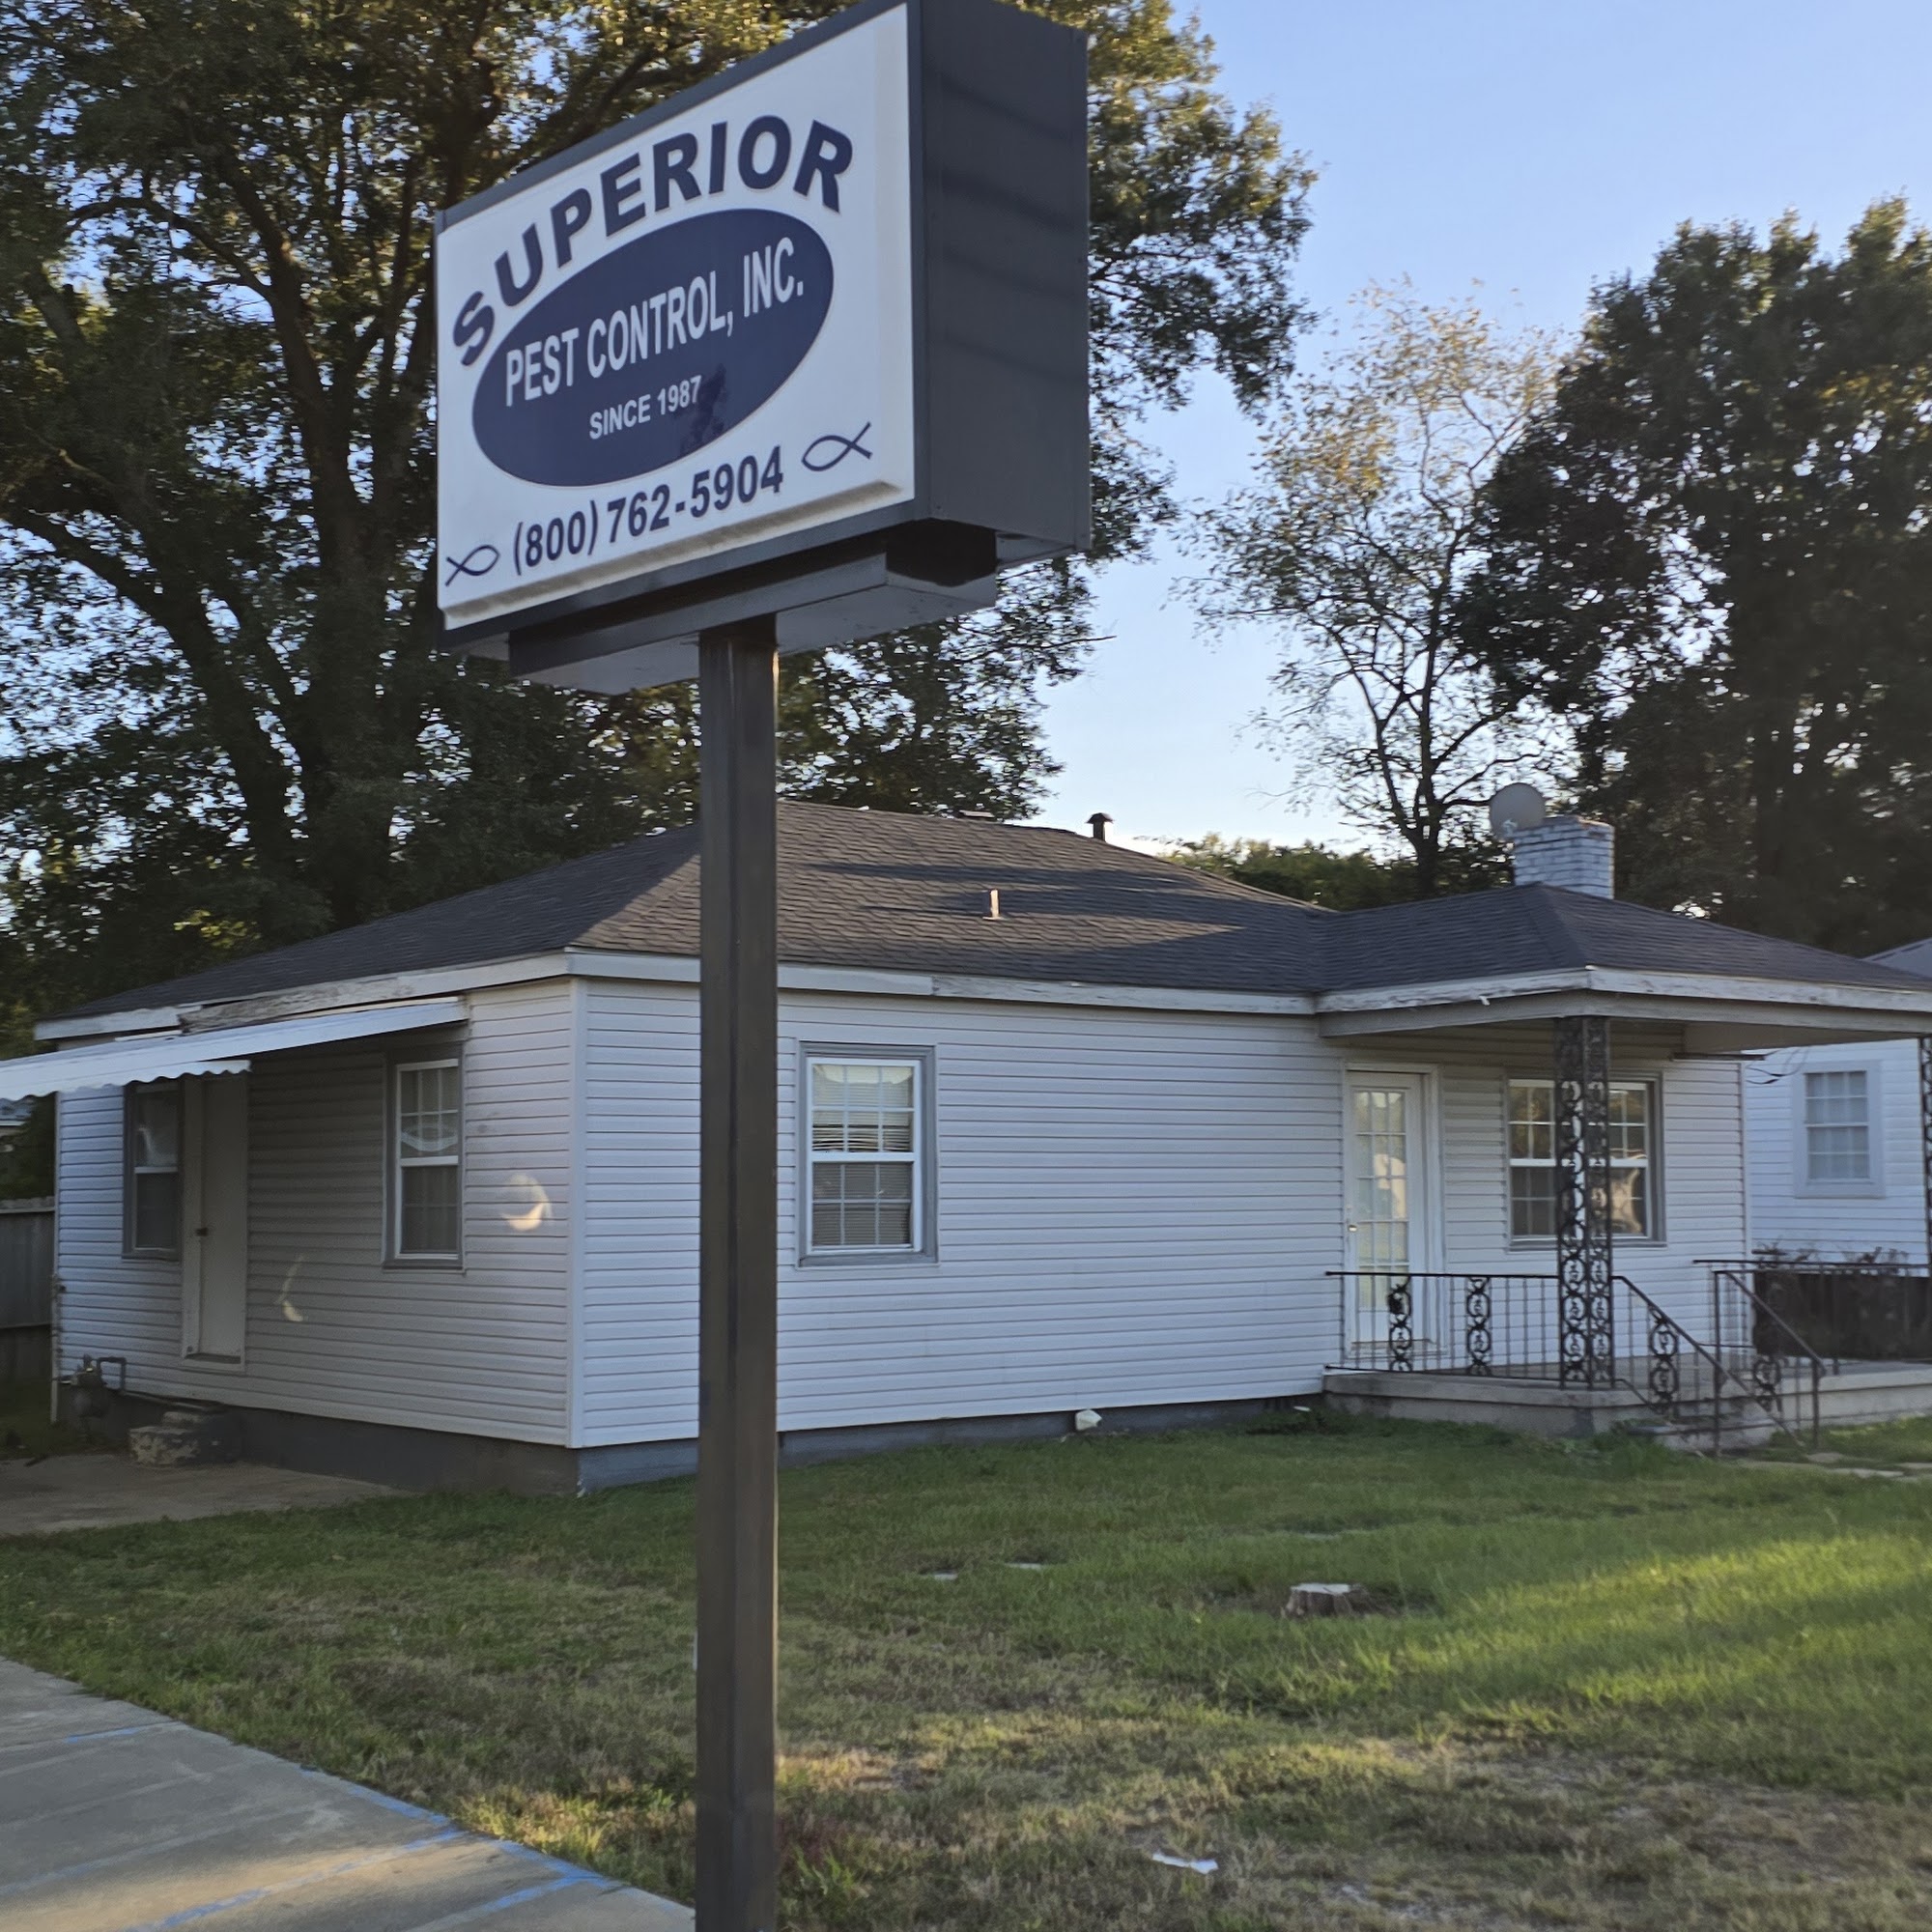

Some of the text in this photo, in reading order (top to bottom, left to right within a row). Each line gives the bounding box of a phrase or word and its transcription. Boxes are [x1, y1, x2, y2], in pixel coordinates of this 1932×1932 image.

[453, 115, 853, 366] SUPERIOR
[506, 237, 804, 406] PEST CONTROL, INC.
[589, 375, 702, 440] SINCE 1987
